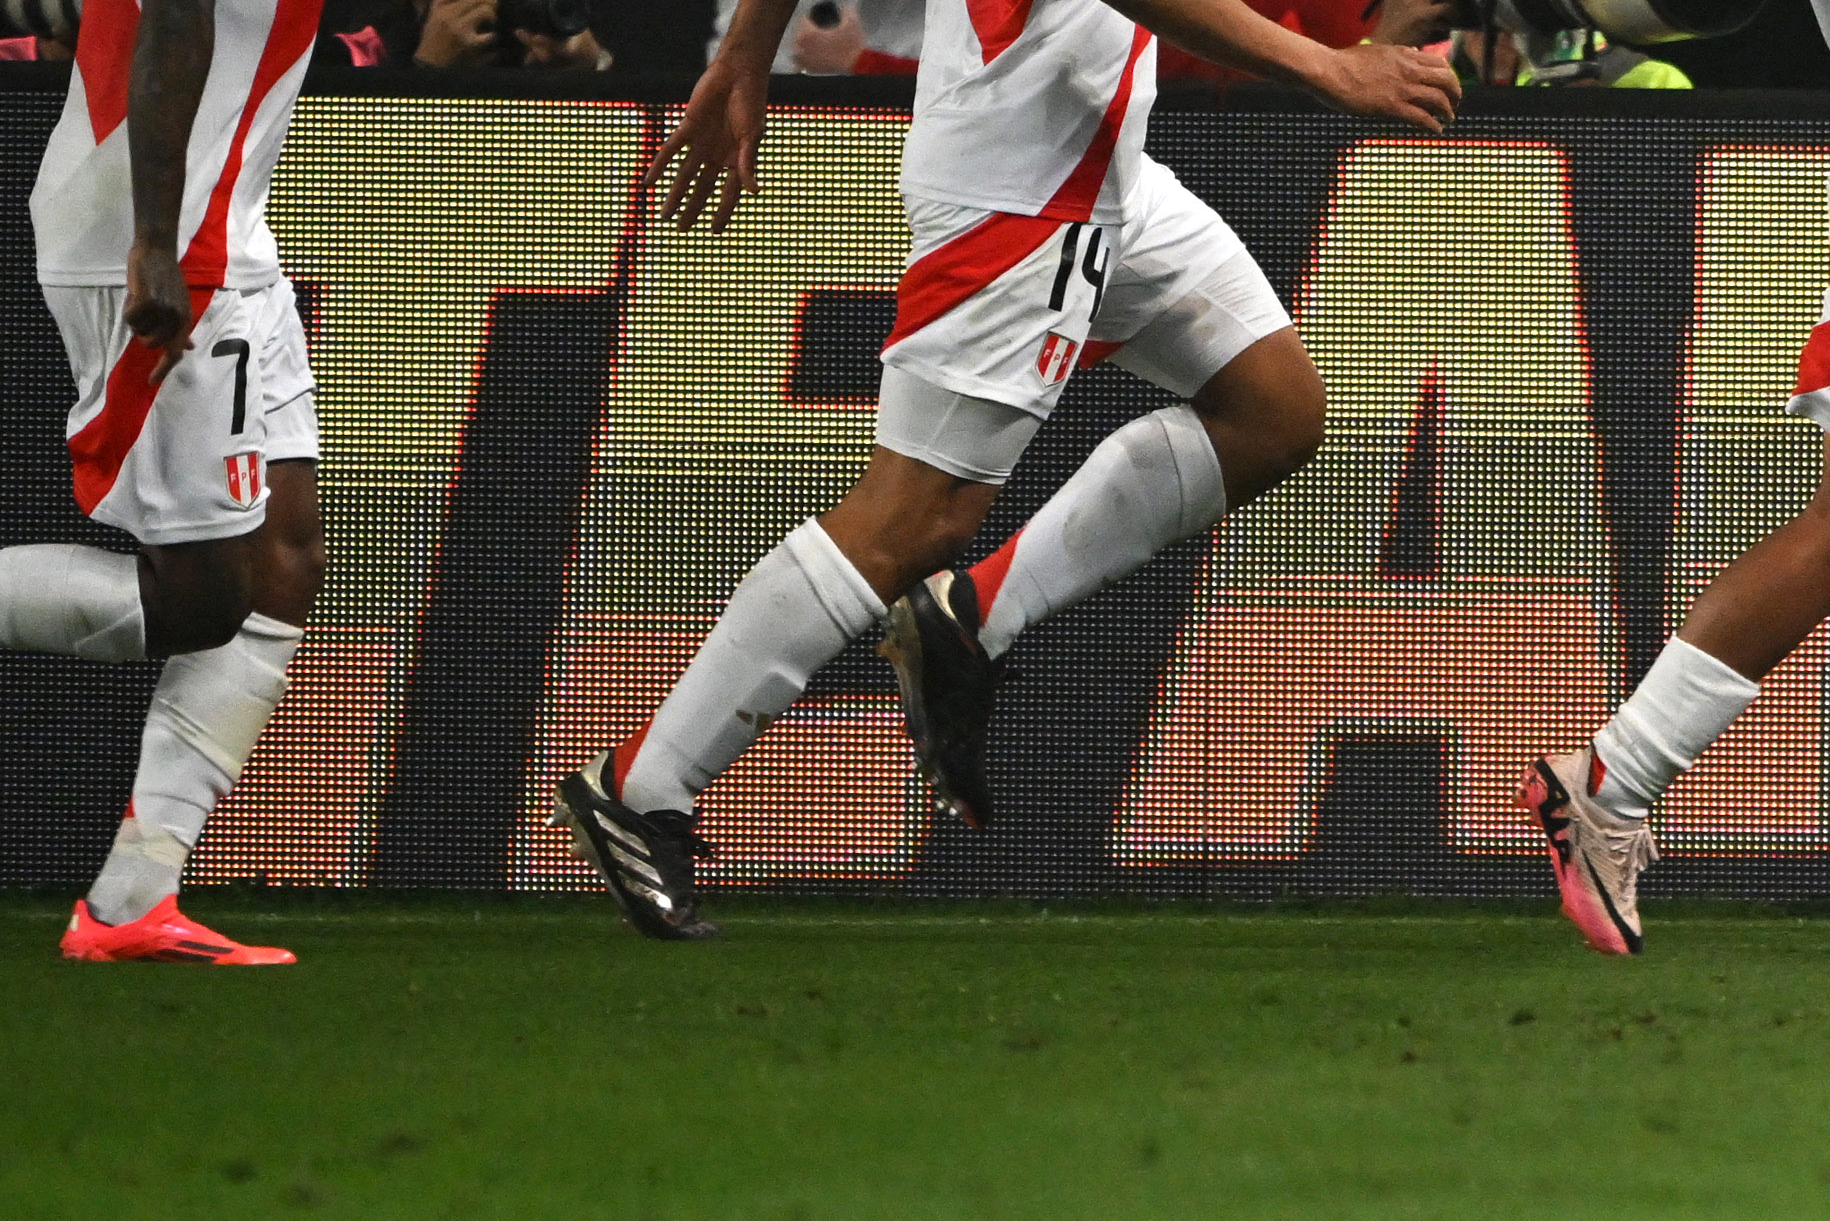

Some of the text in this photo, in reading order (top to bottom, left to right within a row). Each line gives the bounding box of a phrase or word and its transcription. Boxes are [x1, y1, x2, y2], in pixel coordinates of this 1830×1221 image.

[1047, 221, 1110, 323] 14
[1042, 348, 1070, 366] FPF
[211, 338, 250, 436] 7
[229, 469, 256, 484] FPF
